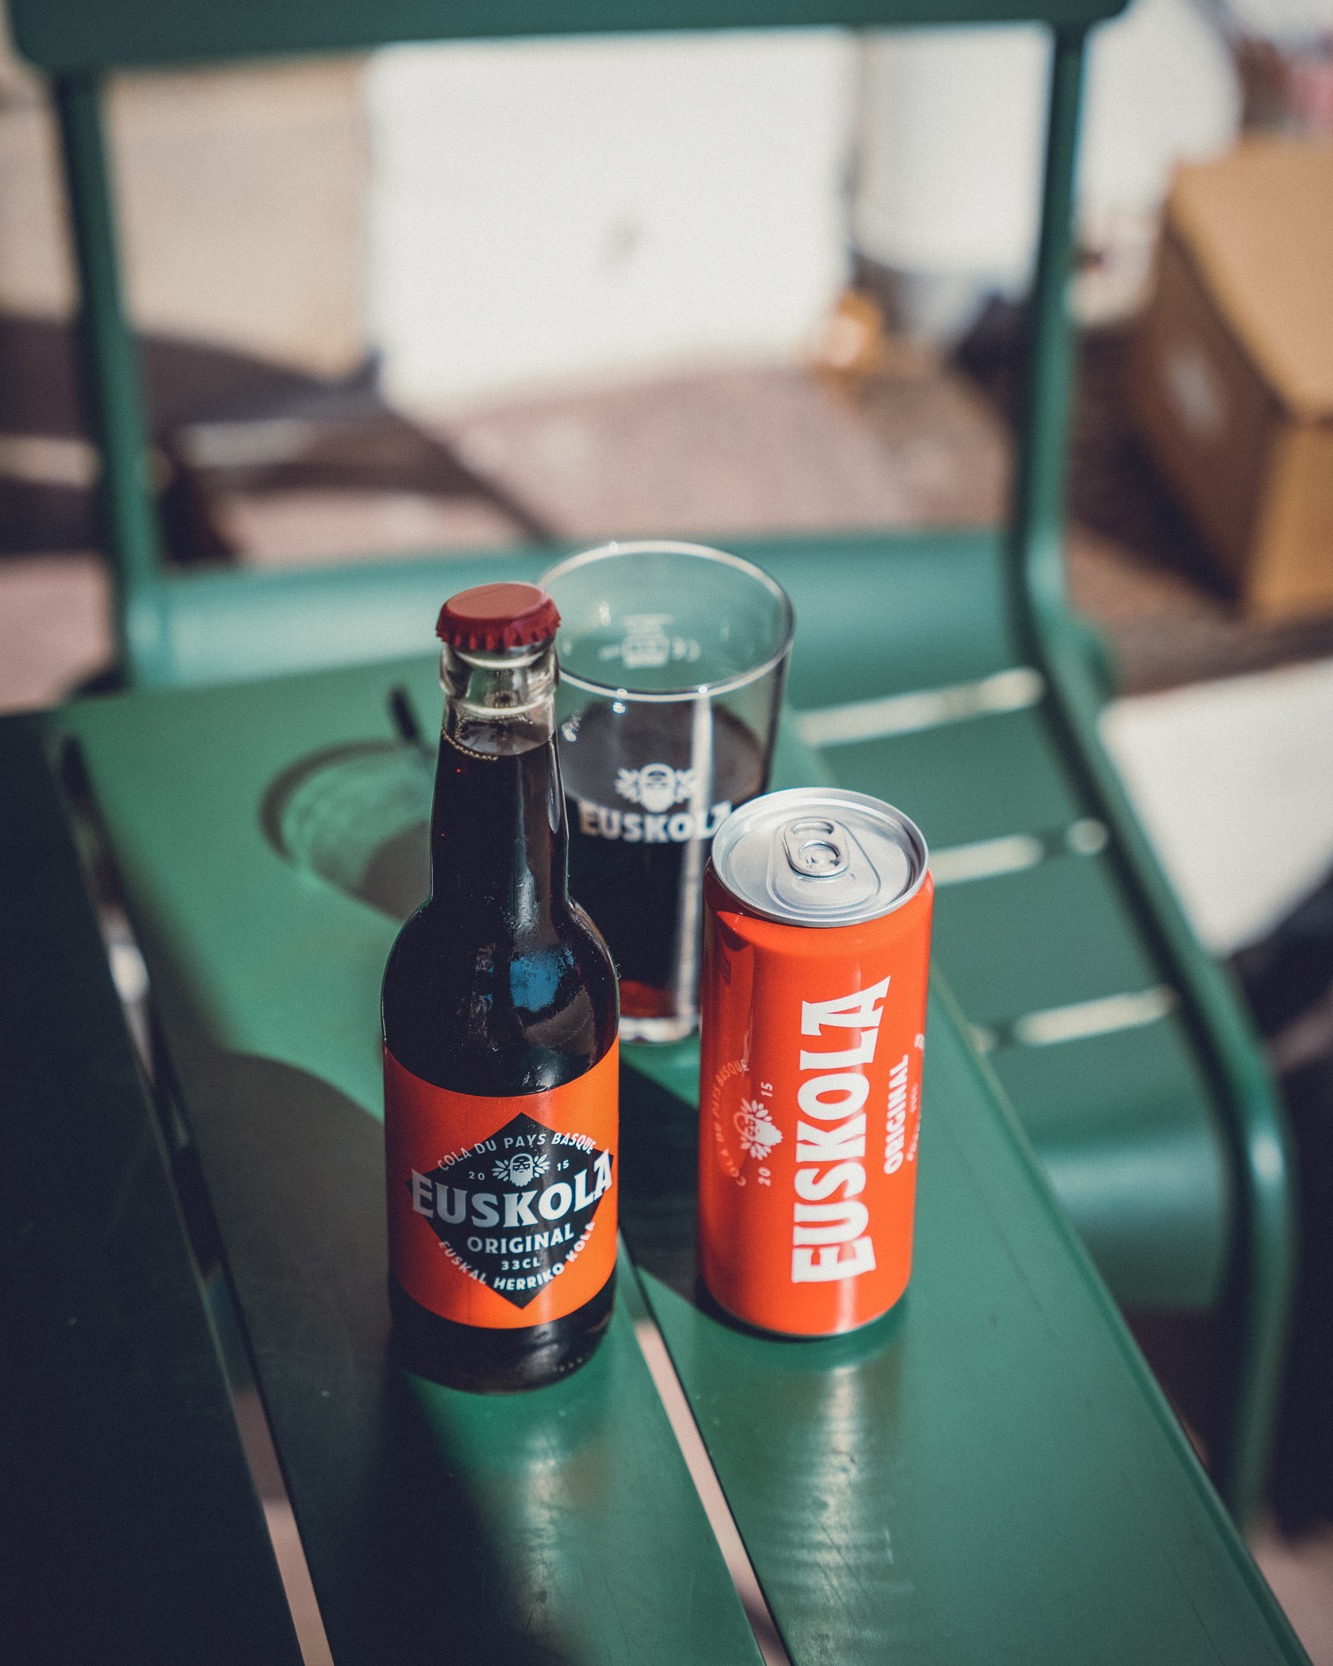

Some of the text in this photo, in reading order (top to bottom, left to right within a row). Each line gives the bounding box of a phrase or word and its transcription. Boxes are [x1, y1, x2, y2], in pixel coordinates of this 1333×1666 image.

[758, 1081, 774, 1187] 20 15
[791, 976, 891, 1284] EUSKOLA
[883, 1053, 910, 1175] ORIGINAL
[438, 1132, 597, 1171] COLA DU PAYS BASQUE
[468, 1159, 570, 1181] 20 15
[411, 1148, 614, 1228] EUSKOLA
[438, 1221, 597, 1291] EUSKAL HERRIKO KOLA
[467, 1223, 575, 1254] ORIGINAL
[501, 1259, 541, 1271] 33CL
